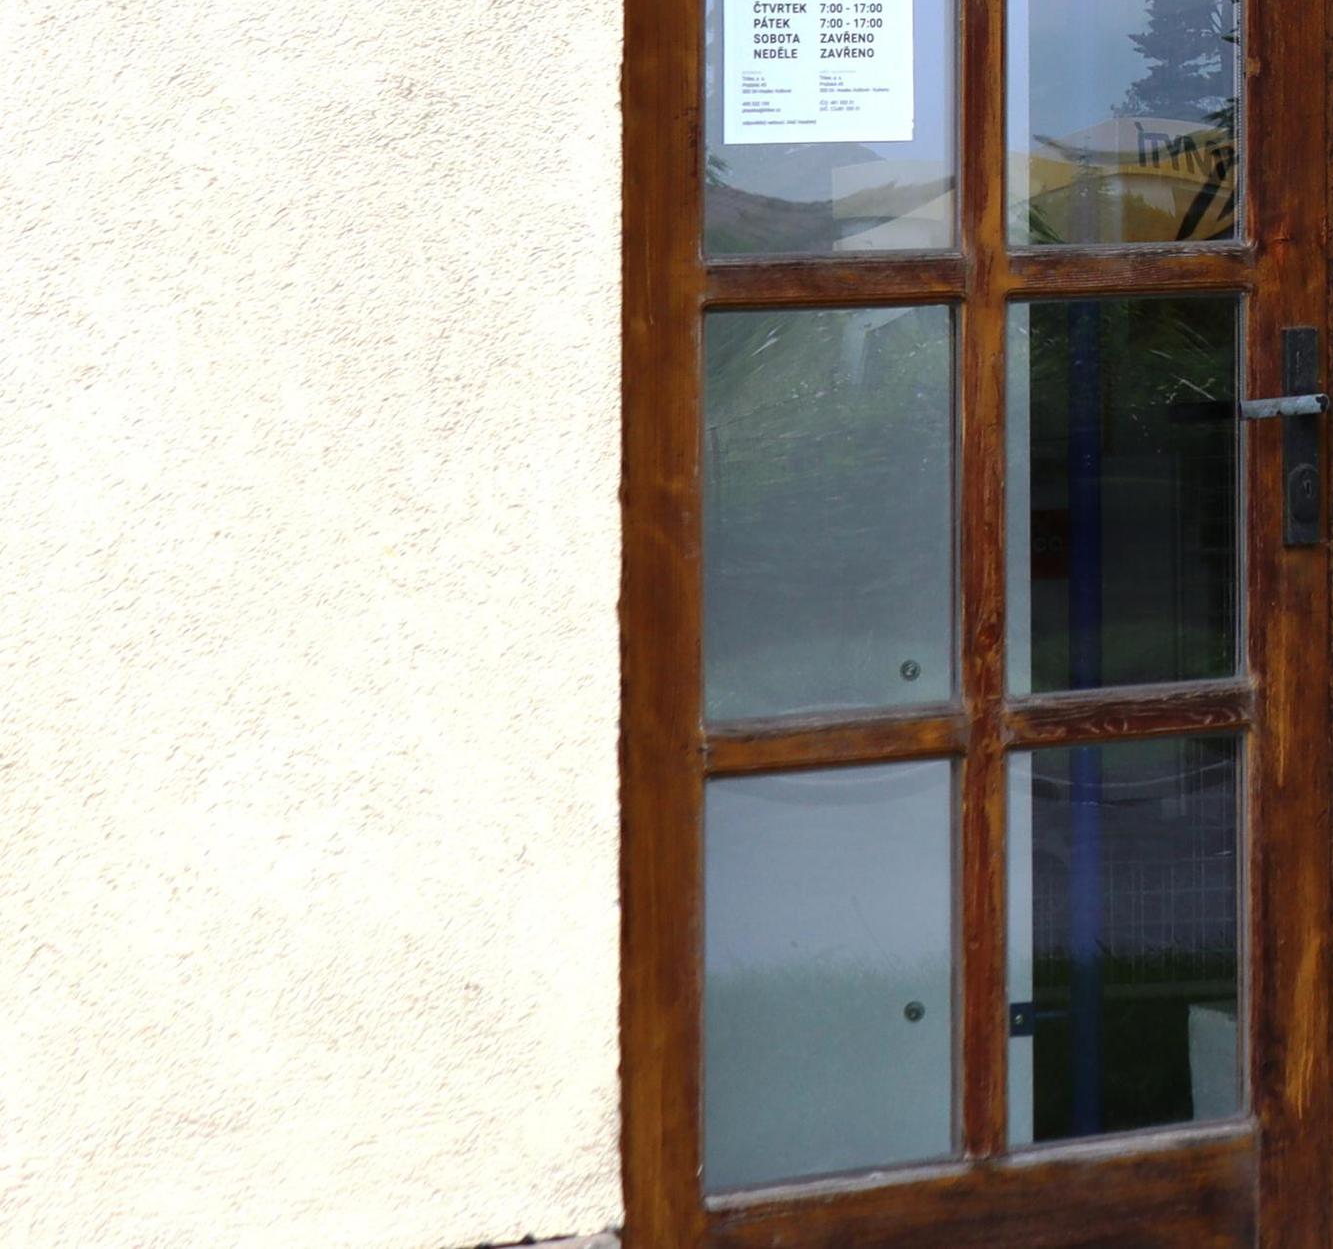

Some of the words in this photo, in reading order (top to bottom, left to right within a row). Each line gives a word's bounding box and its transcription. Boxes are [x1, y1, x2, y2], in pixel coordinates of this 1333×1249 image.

[754, 1, 807, 14] ČTVRTEK
[820, 3, 843, 13] 7:00
[854, 3, 883, 13] 17:00
[754, 16, 790, 29] PÁTEK
[820, 18, 843, 28] 7:00
[854, 18, 883, 28] 17:00
[754, 33, 800, 44] SOBOTA
[820, 31, 874, 43] ZAVŘENO
[754, 47, 798, 59] NEDĚLE
[820, 46, 874, 58] ZAVŘENO
